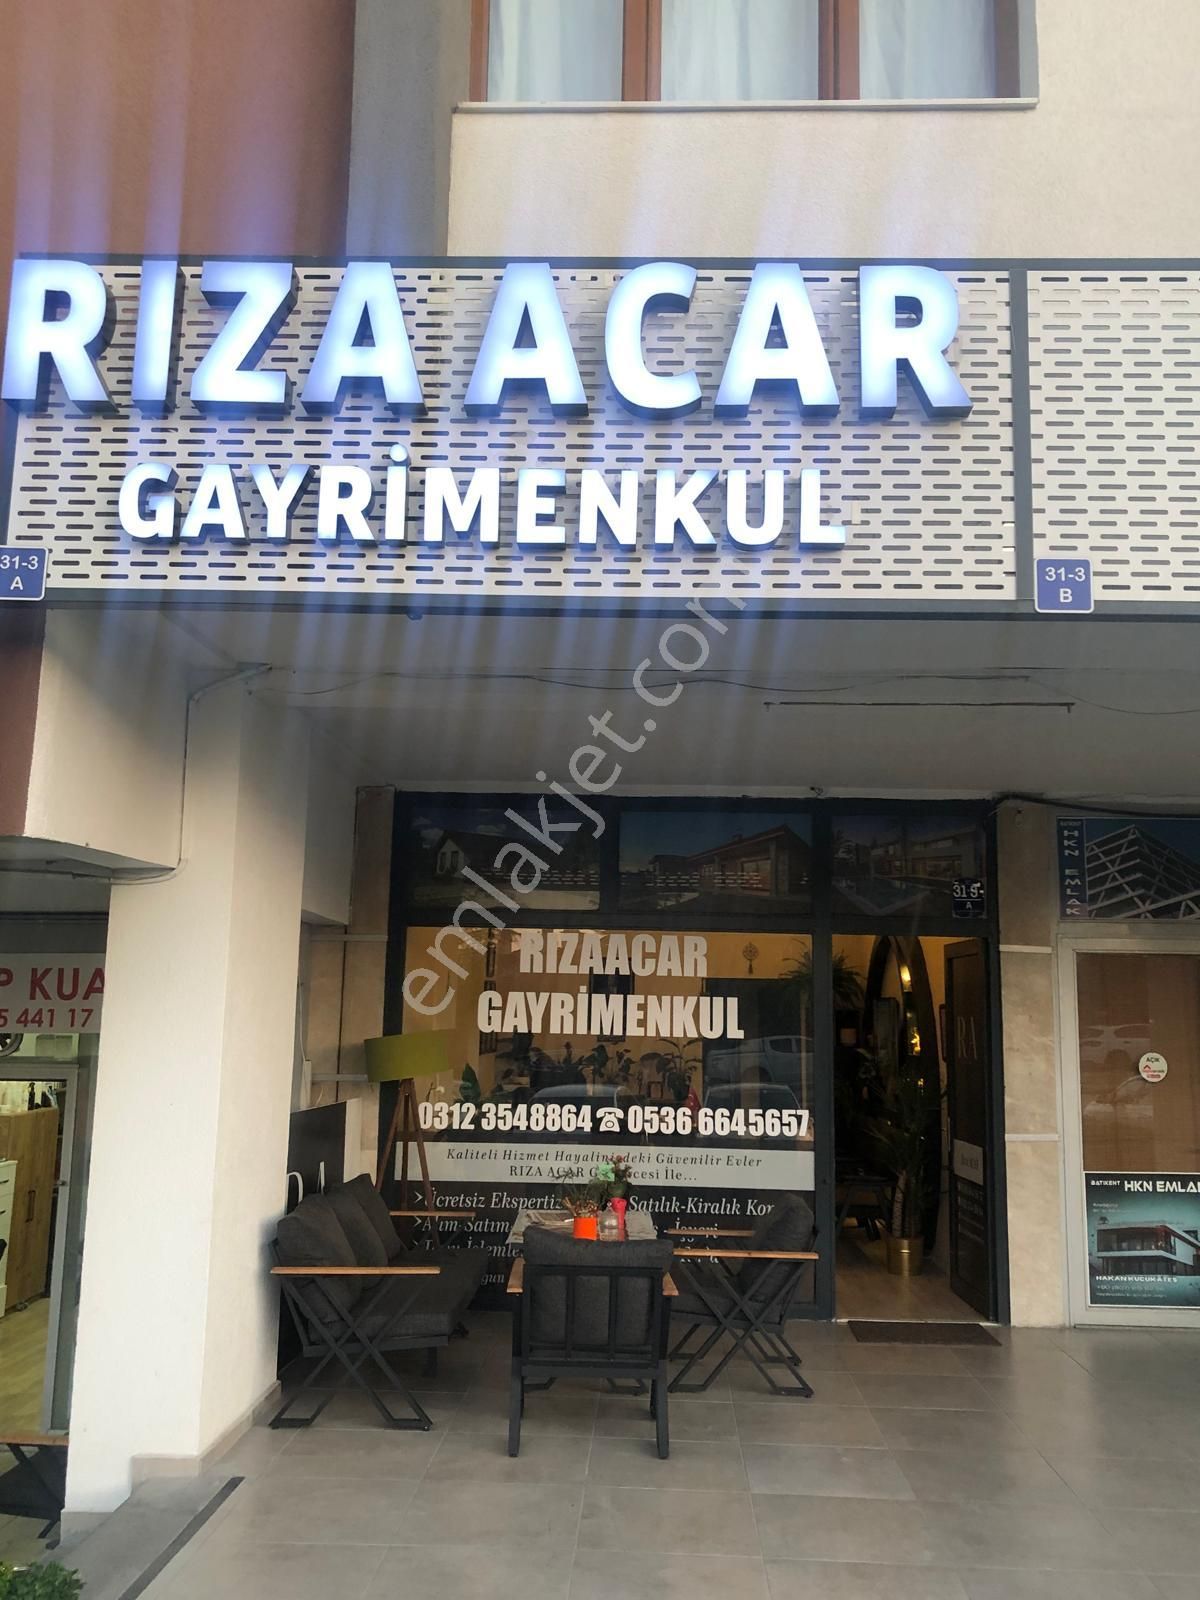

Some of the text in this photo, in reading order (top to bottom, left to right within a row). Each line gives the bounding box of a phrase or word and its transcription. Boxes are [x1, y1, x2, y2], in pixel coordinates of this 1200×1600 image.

[0, 259, 973, 418] RIZA ACAR
[118, 443, 846, 550] GAYRİMENKUL
[0, 555, 39, 571] 31-3
[1044, 566, 1086, 582] 31-3
[10, 577, 24, 592] A
[1059, 587, 1073, 604] B
[16, 1008, 55, 1028] 441
[69, 1008, 94, 1028] 17
[477, 985, 745, 1040] GAYRİMENKUL
[418, 1101, 593, 1133] 0312 3548864
[627, 1104, 810, 1138] 0536 6645657
[447, 1148, 763, 1168] Kaliteli Hizmet Hayalinideki Güvenilir Evler
[510, 1165, 543, 1177] RIZA
[1124, 1180, 1153, 1192] HKN
